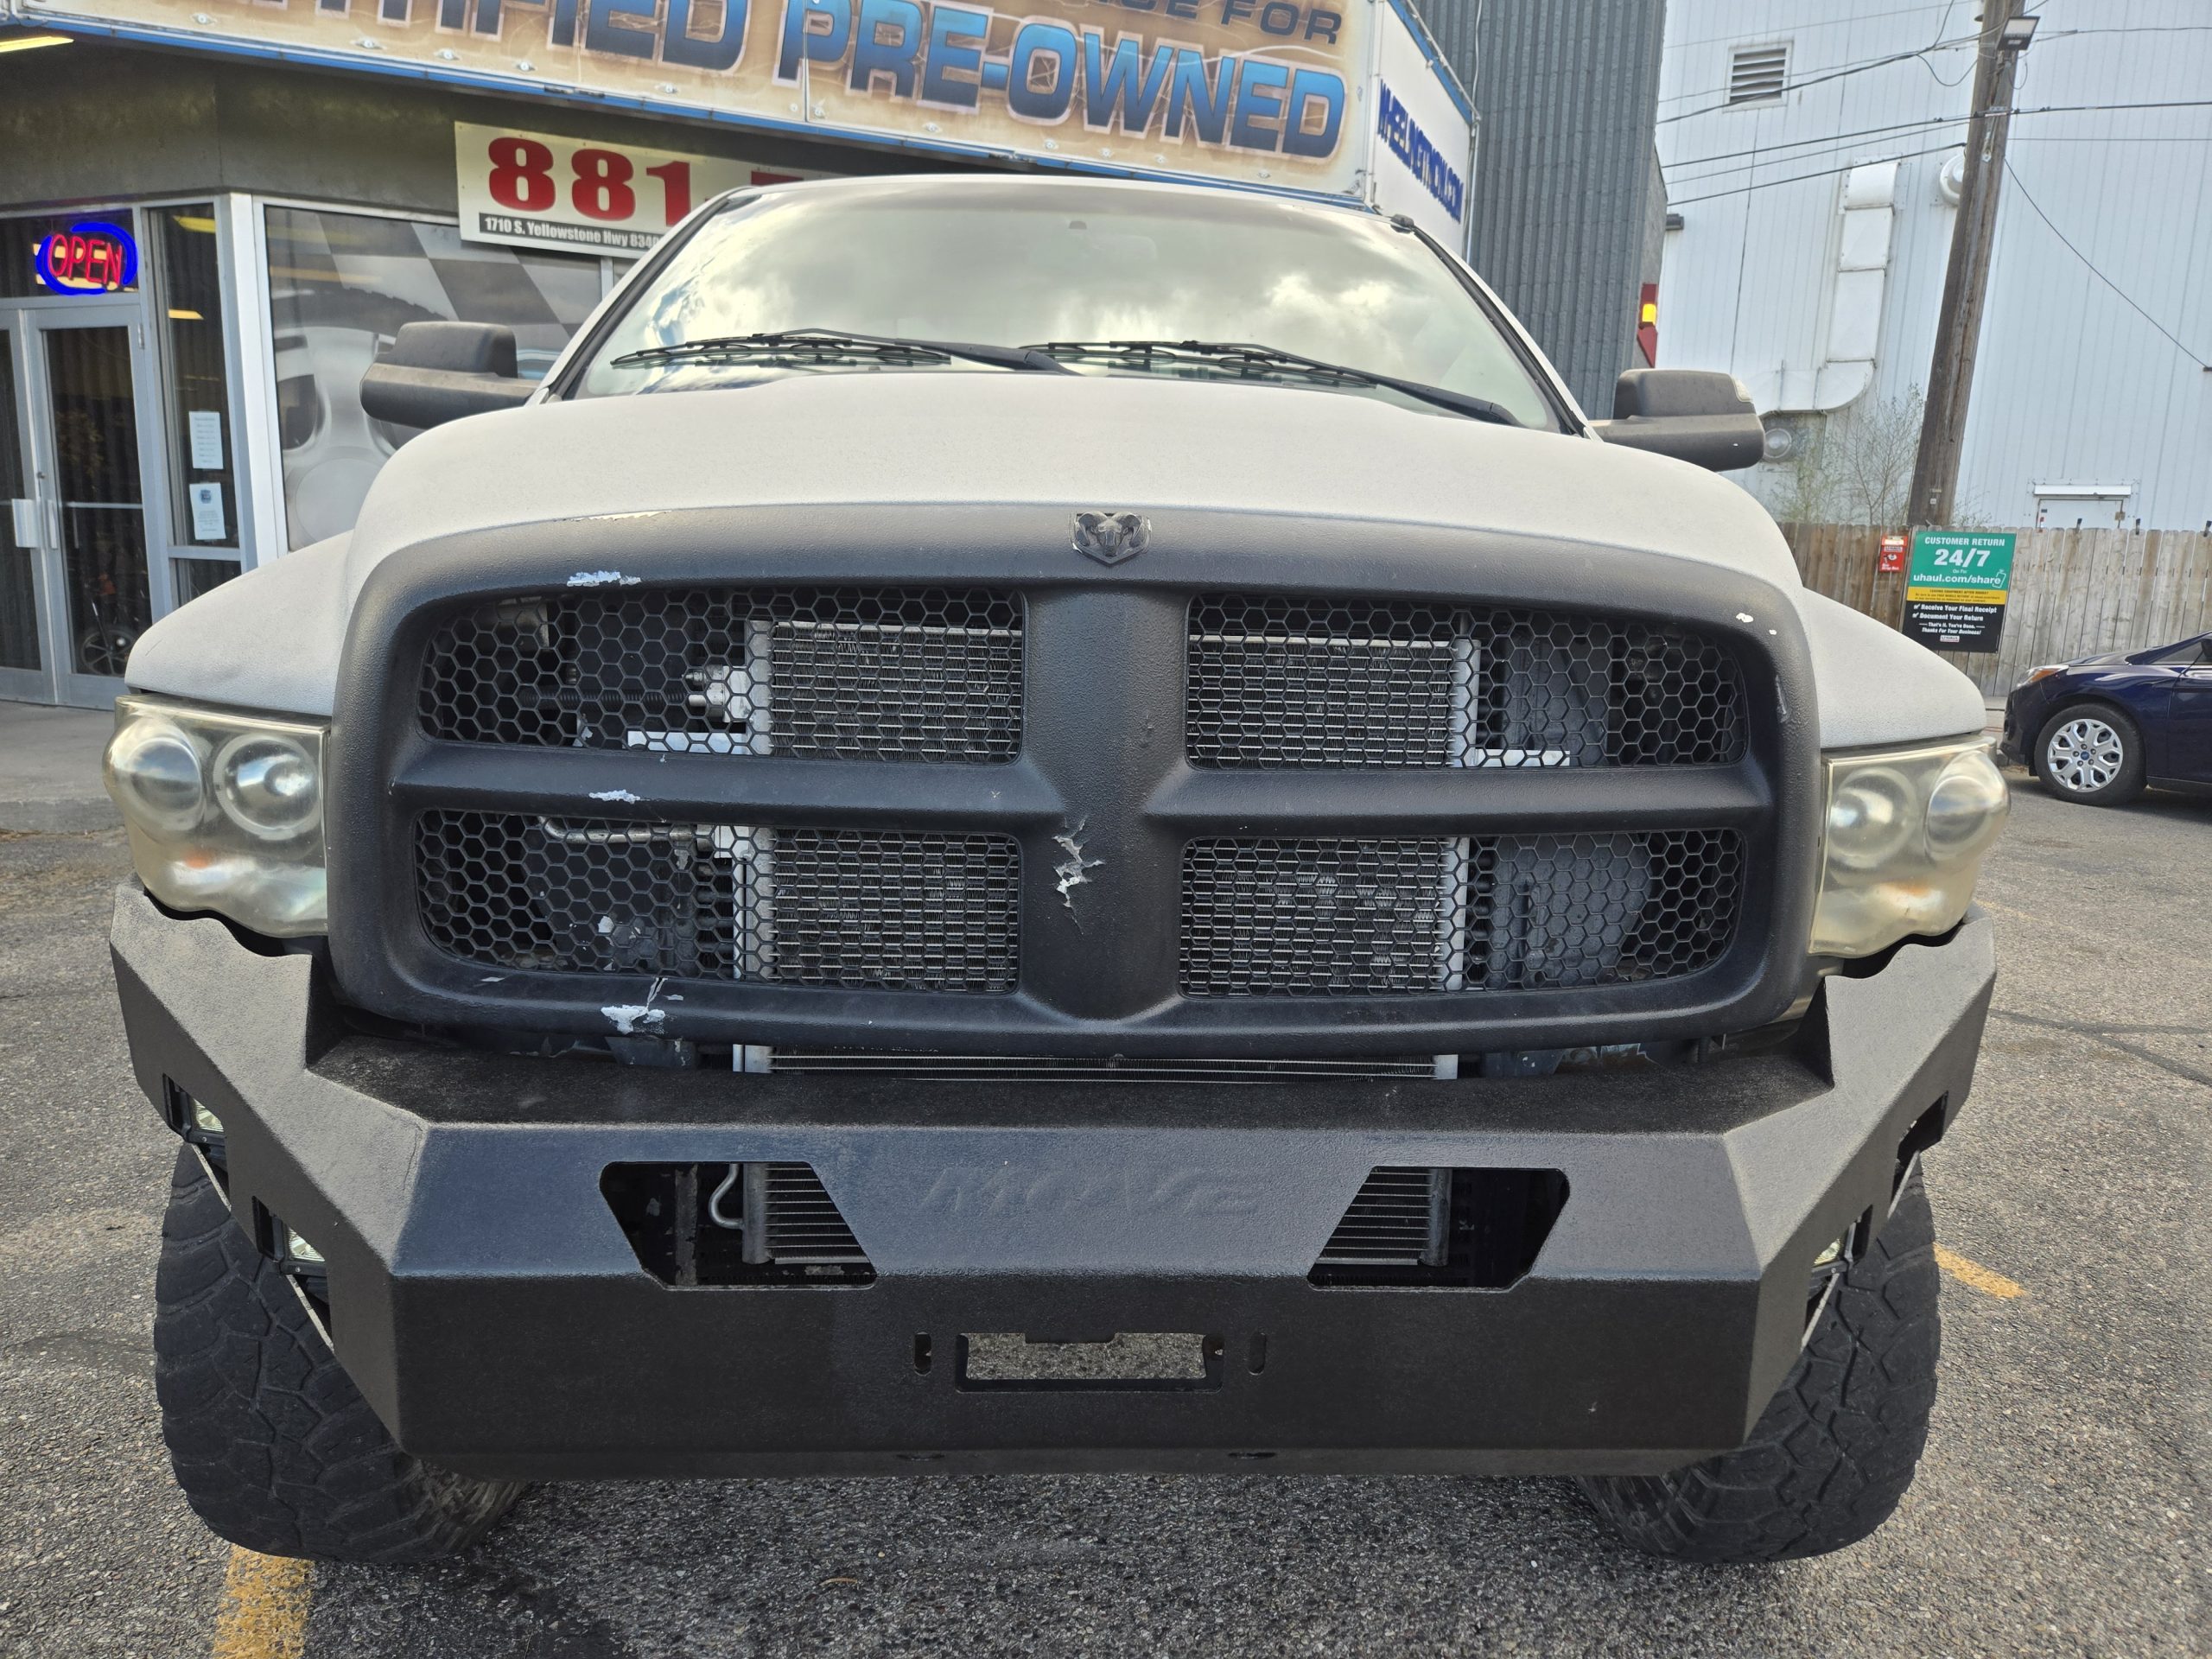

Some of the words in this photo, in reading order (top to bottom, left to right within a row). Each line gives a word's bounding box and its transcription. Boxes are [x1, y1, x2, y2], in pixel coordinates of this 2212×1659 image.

[1221, 0, 1342, 44] FOR
[775, 0, 1348, 161] PRE-OWNED
[486, 217, 512, 233] 1710
[514, 222, 525, 235] S.
[527, 222, 601, 244] Yellowstone
[603, 231, 628, 248] Hwy
[48, 233, 123, 286] OPEN
[1924, 537, 1969, 545] CUSTOMER
[1972, 537, 2005, 546] RETURN
[1934, 548, 1991, 568] 24/7
[1913, 574, 2001, 584] uhaul.com/share
